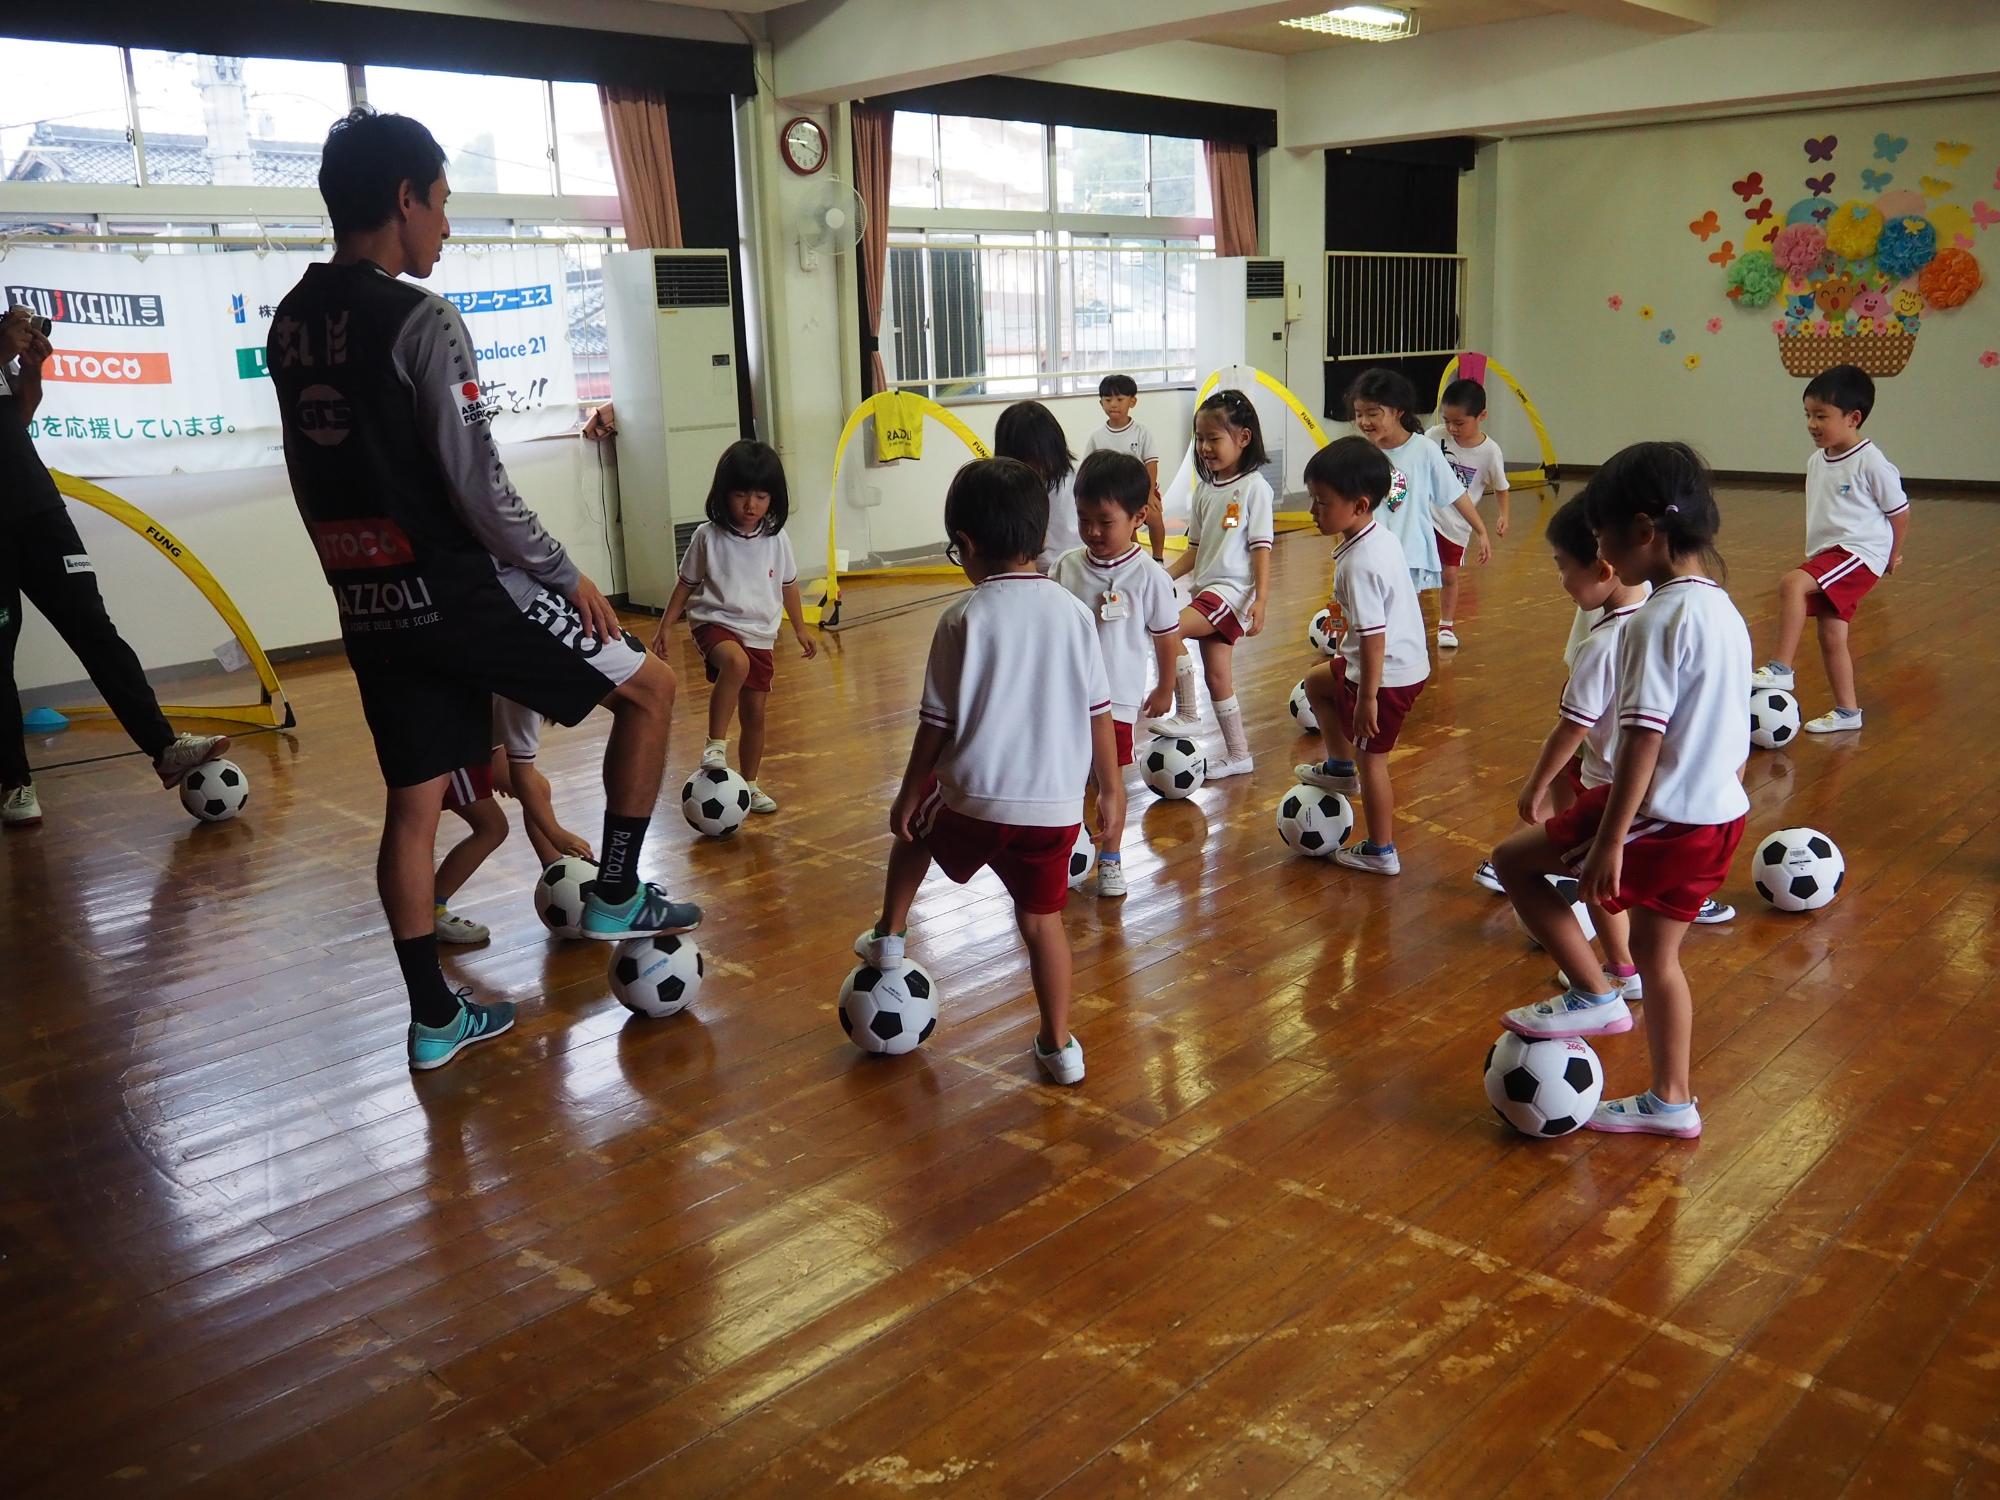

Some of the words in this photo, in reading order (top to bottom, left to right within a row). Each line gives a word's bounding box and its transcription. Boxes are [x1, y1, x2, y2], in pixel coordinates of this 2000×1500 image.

[463, 287, 549, 312] ジーケーエス
[529, 336, 547, 354] 21
[462, 402, 484, 415] ASA
[146, 526, 181, 558] FUNG
[601, 830, 632, 883] RAZZOLI
[1566, 1042, 1586, 1053] 260g
